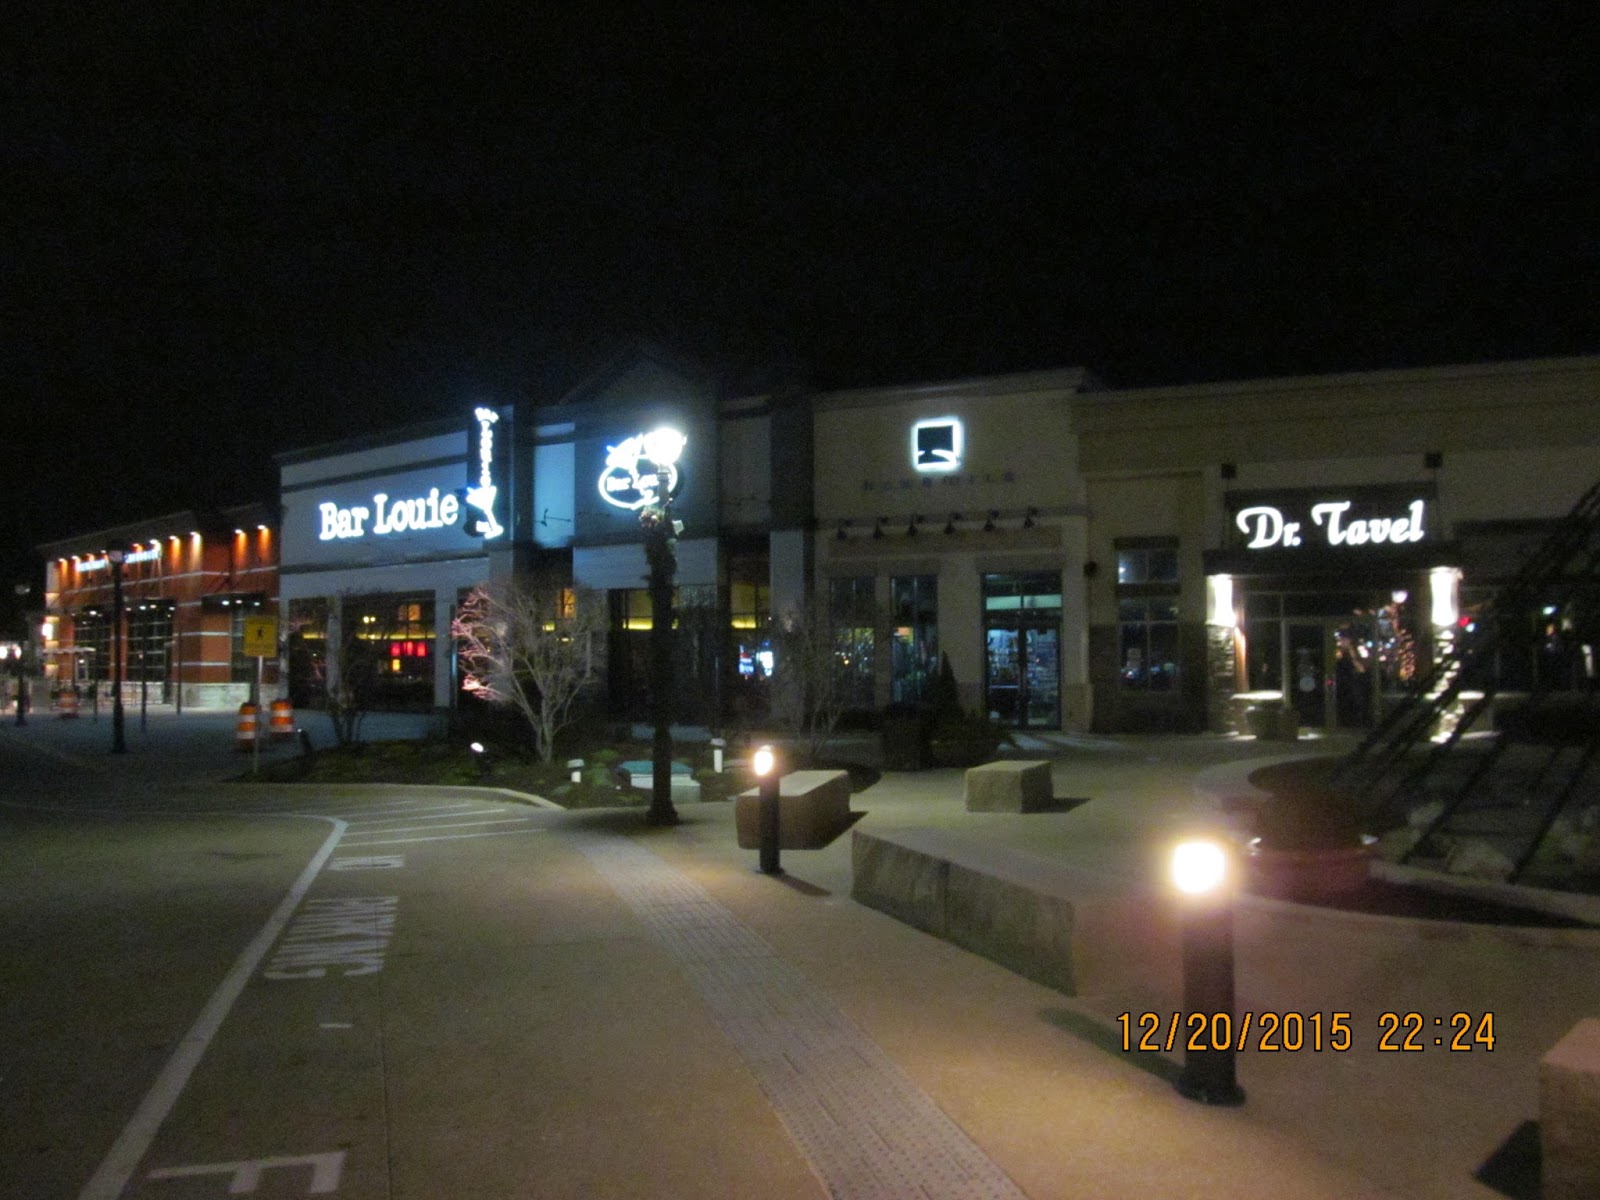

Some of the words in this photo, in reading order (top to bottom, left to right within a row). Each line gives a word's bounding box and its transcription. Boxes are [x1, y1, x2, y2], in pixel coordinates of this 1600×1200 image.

[319, 502, 370, 541] Bar
[373, 487, 459, 535] Louie
[1235, 506, 1302, 549] Dr.
[1310, 499, 1425, 546] Tavel
